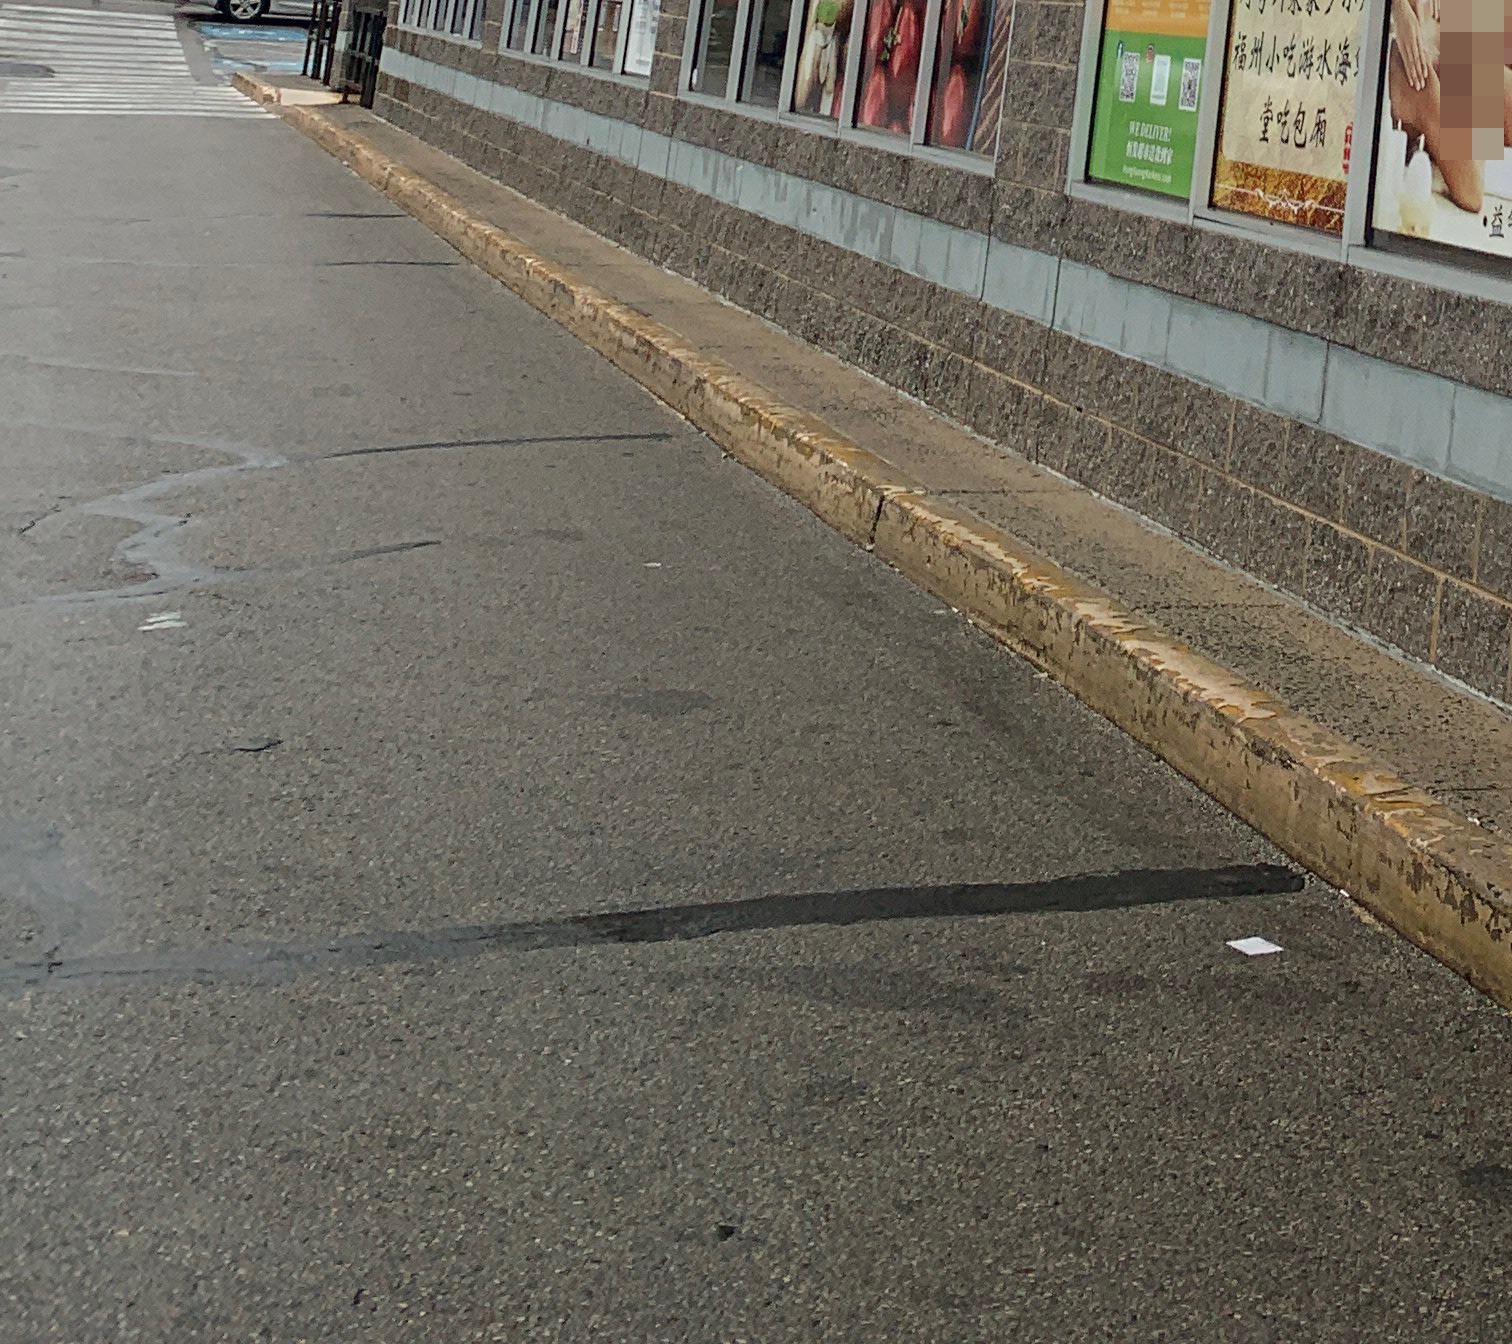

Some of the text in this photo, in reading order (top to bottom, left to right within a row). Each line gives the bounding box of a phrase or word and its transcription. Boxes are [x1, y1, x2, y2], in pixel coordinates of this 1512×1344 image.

[1232, 31, 1360, 87] 福州小吃游水海
[1140, 122, 1172, 143] DELIVER!
